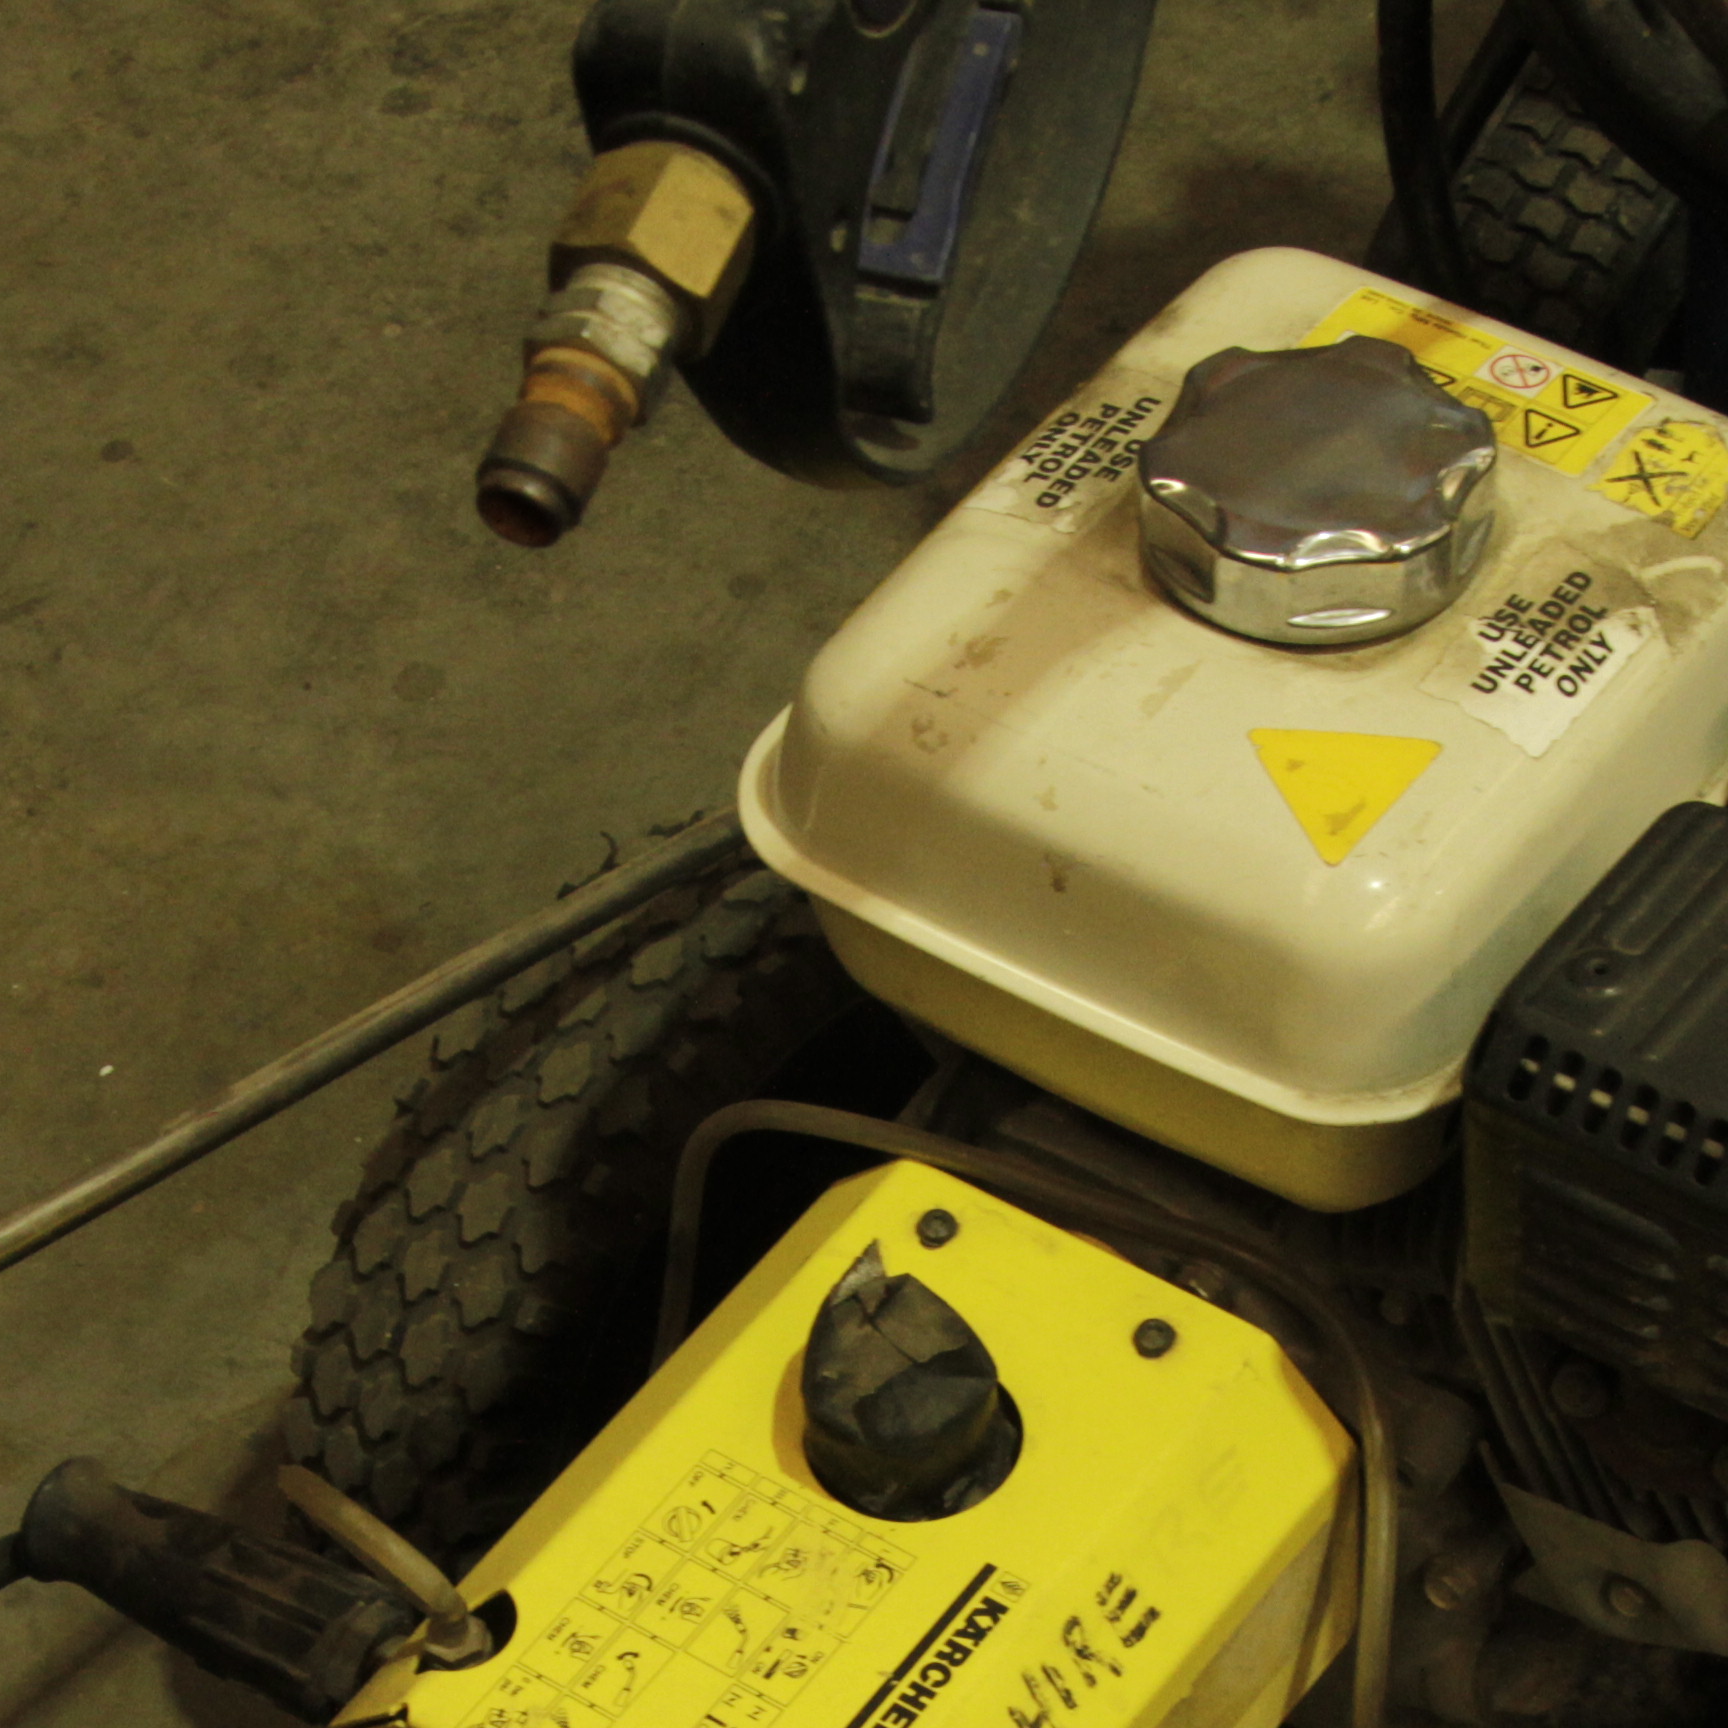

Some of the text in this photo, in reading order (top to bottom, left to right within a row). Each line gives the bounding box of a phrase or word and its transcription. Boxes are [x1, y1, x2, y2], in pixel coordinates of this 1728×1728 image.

[1021, 412, 1080, 465] ONLY
[1023, 403, 1122, 482] PETROL
[1036, 397, 1161, 507] UNLEADED
[1094, 439, 1145, 482] USE
[1471, 571, 1592, 694] UNLEADED
[1478, 593, 1534, 642] USE
[1513, 605, 1608, 694] PETROL
[1556, 631, 1614, 697] ONLY
